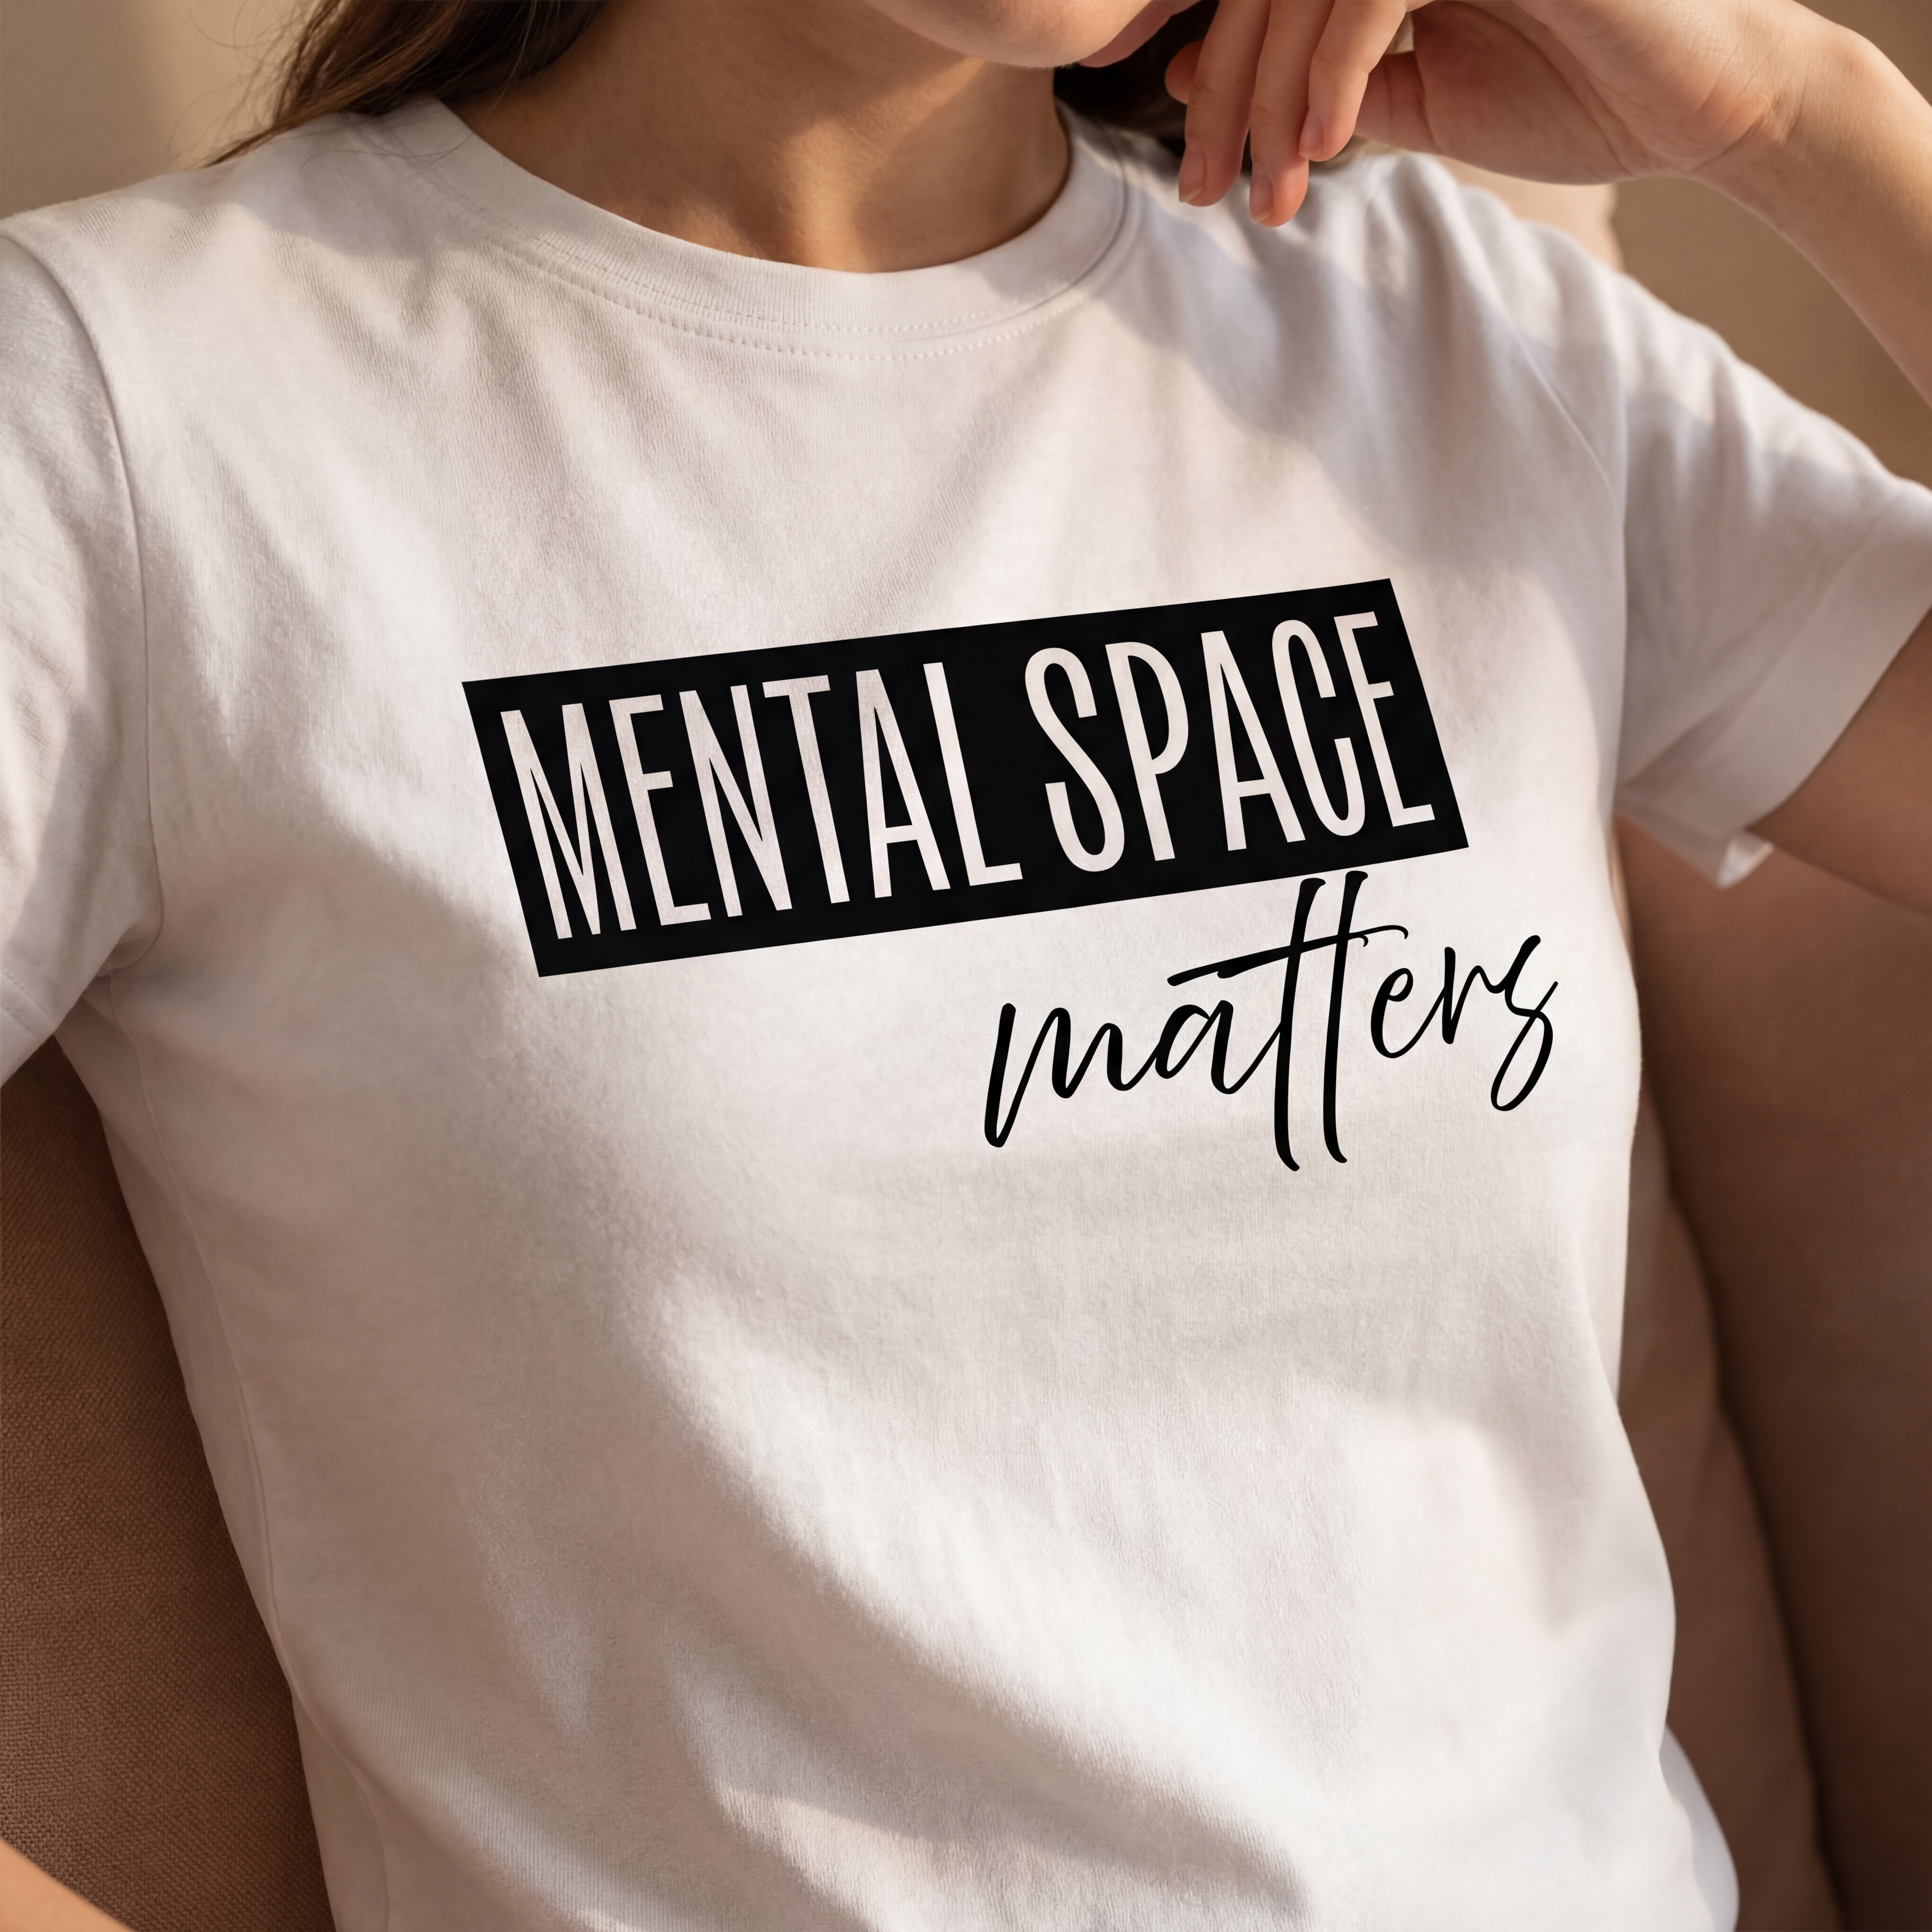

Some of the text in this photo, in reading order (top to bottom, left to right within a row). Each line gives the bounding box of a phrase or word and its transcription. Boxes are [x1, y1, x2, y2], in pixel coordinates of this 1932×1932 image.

[500, 611, 1435, 939] MENTAL SPACE
[984, 870, 1559, 1172] matters
